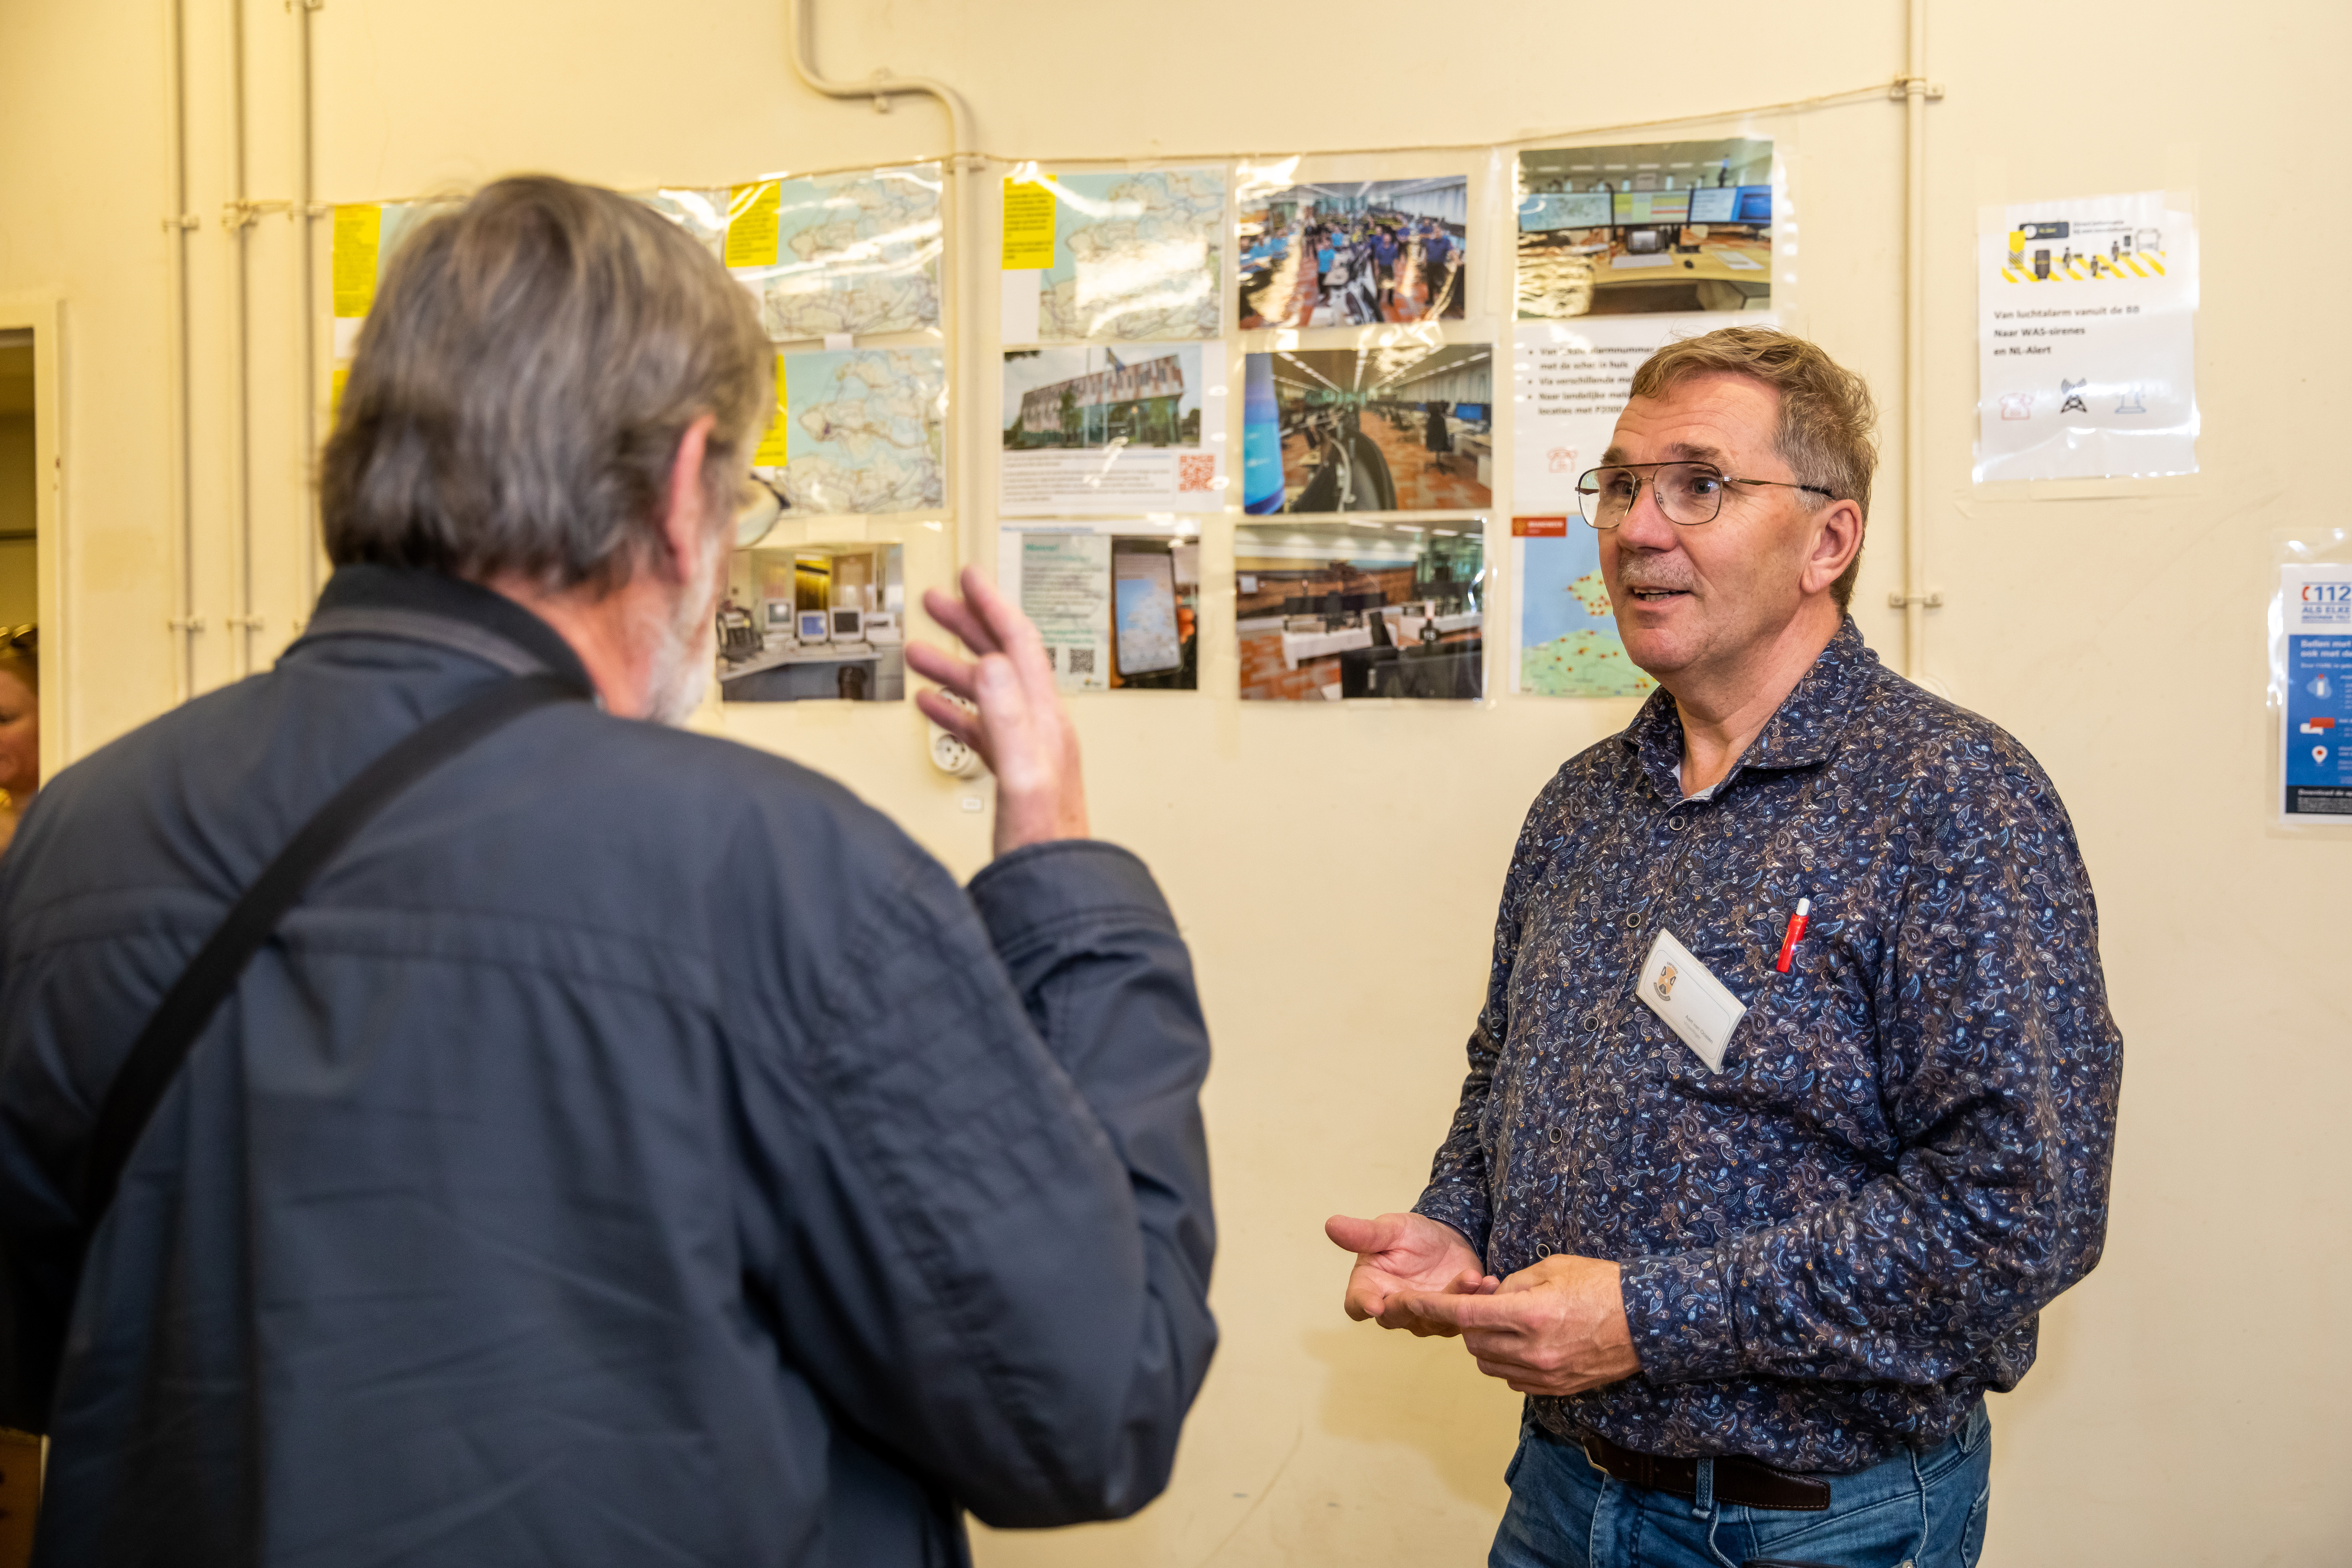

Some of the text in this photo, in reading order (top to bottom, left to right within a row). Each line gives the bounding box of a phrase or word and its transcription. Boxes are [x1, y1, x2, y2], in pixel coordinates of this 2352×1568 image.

[1994, 311, 2014, 319] Van
[2017, 309, 2072, 318] luchtalarm
[2074, 307, 2107, 316] vanuit
[2021, 327, 2085, 336] WAS-sirenes
[2009, 345, 2051, 355] NL-Alert
[1539, 377, 1553, 385] Via
[1564, 391, 1605, 401] landelijke
[2315, 587, 2351, 601] 112
[1701, 1029, 1713, 1044] Oosten
